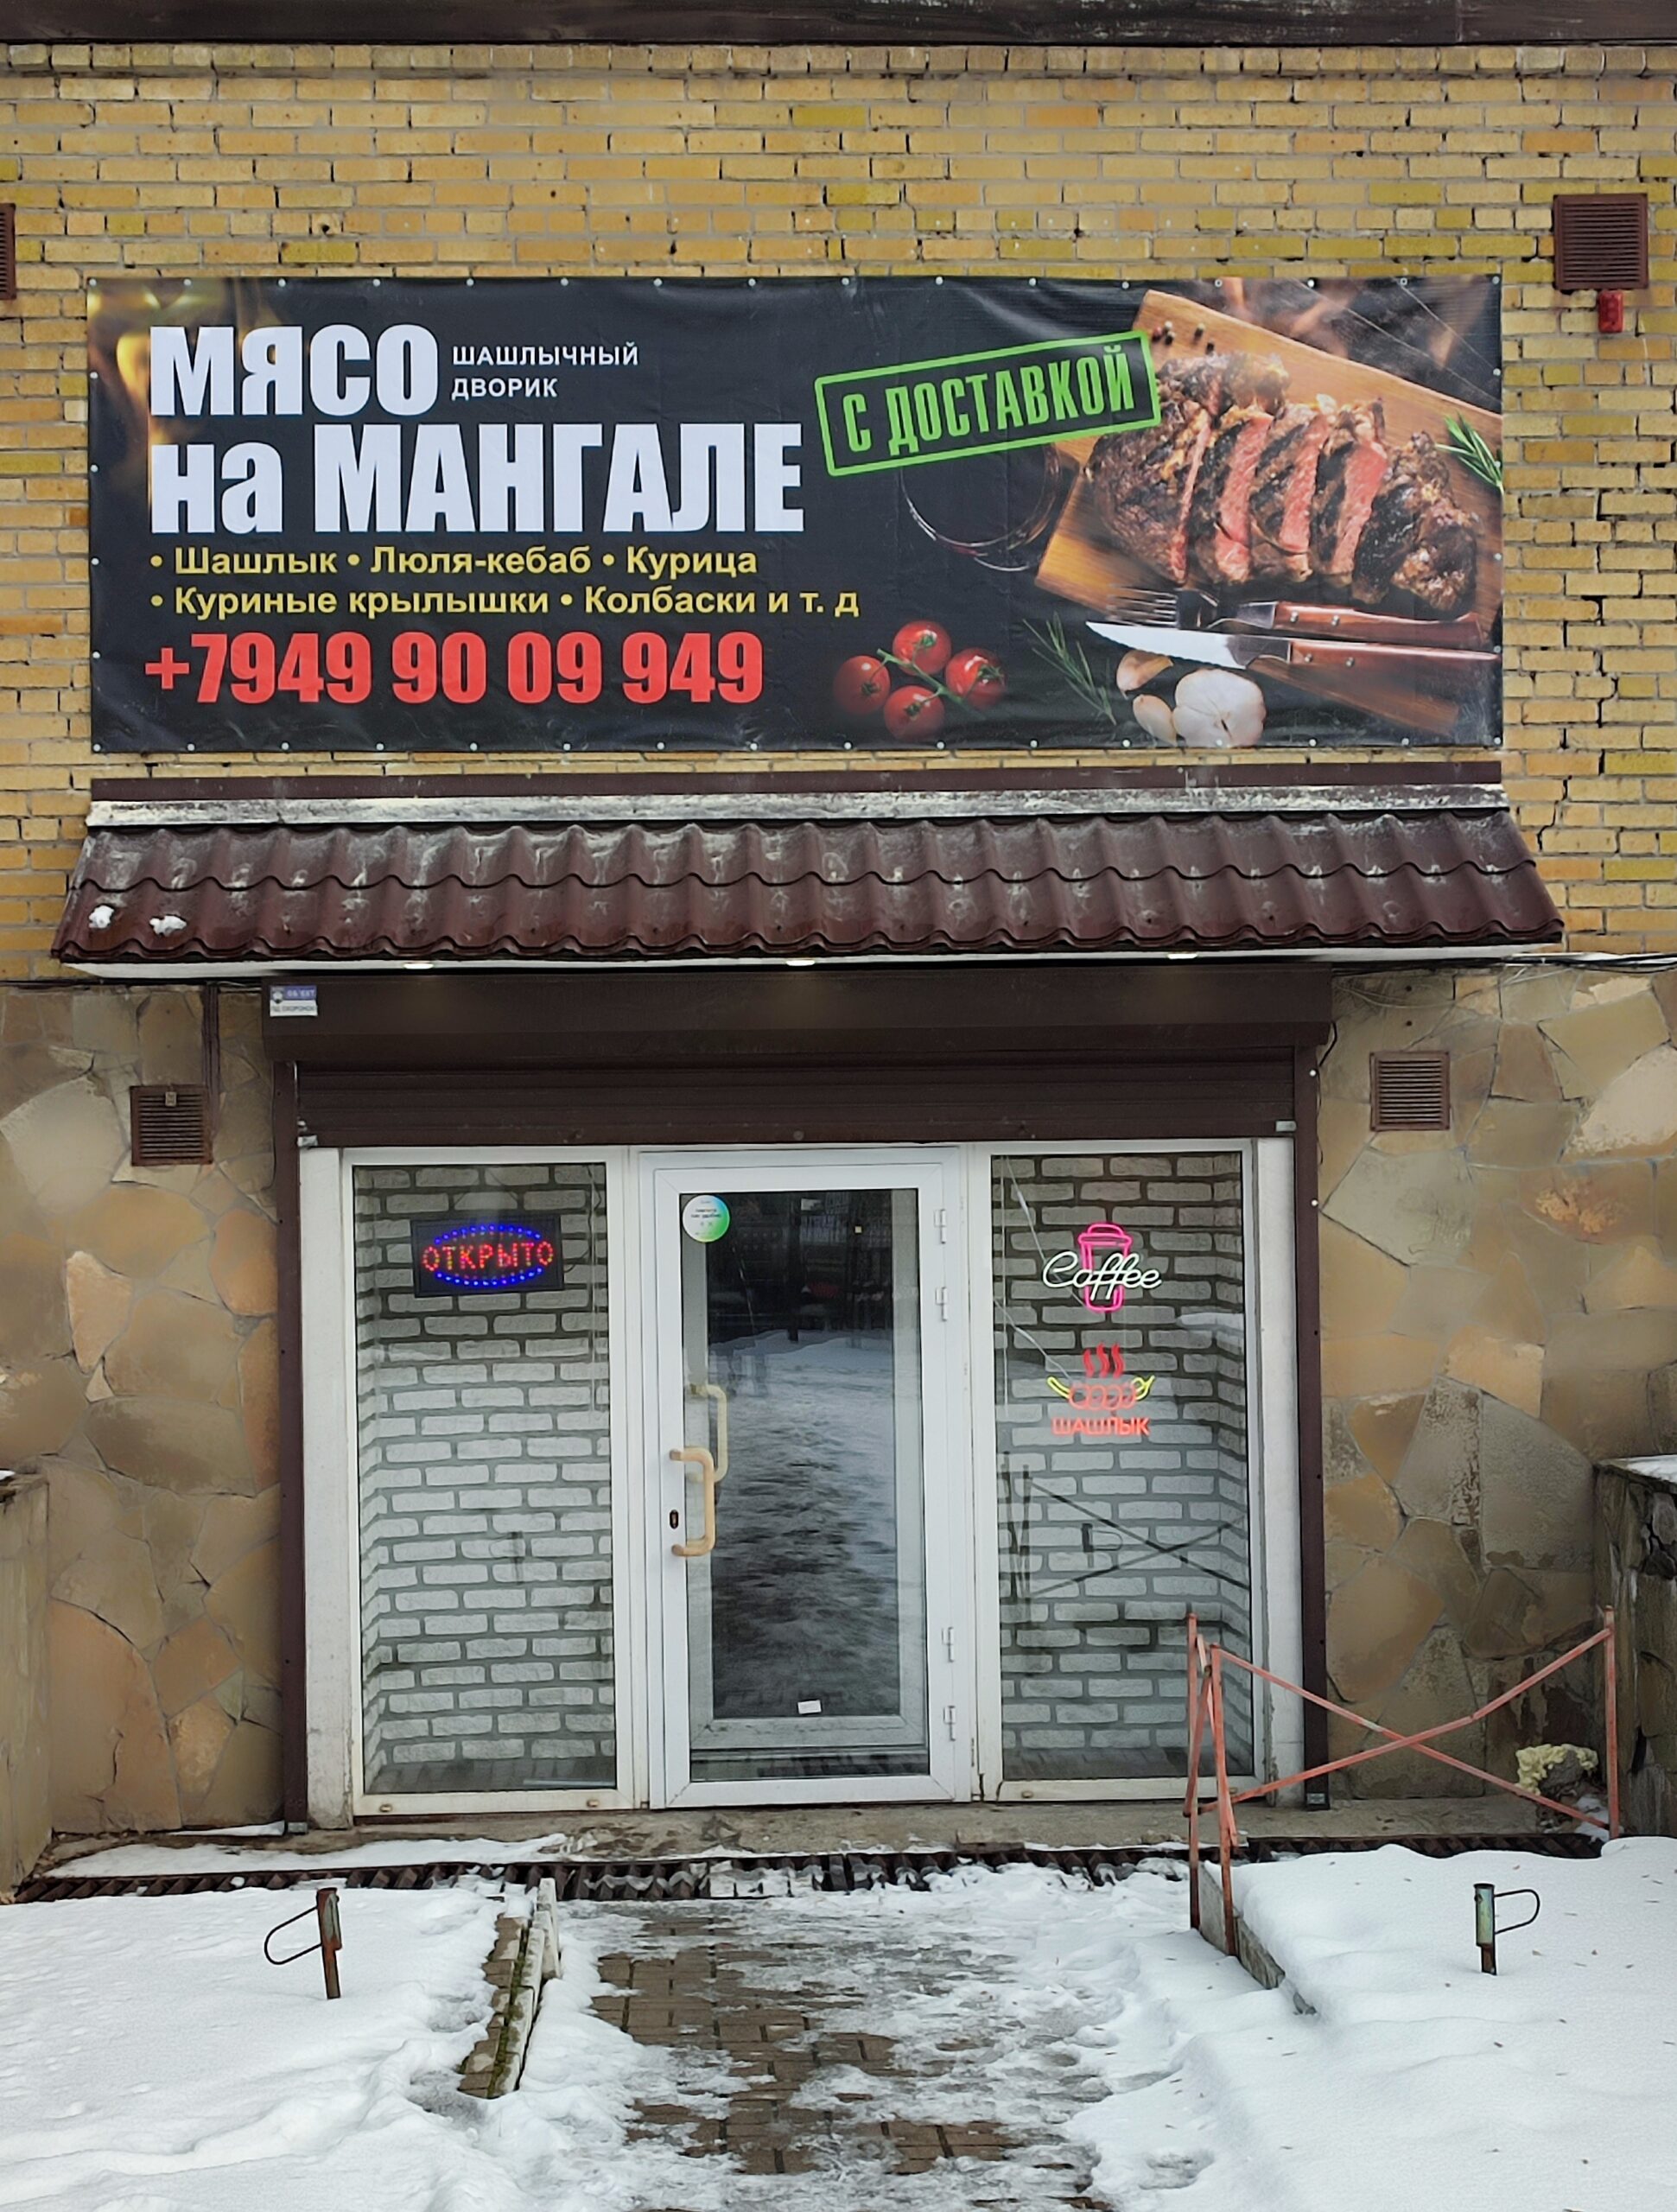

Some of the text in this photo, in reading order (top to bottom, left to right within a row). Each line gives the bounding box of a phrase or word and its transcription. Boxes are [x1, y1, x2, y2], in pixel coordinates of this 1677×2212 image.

[452, 341, 638, 365] ШАШЛЫЧНЫЙ
[451, 378, 558, 401] ДВОРИК
[842, 343, 1135, 456] С ДОСТАВКОЙ
[149, 423, 804, 534] на МАНГАЛЕ
[175, 545, 757, 580] Шашлык Люля-кебаб Курица
[175, 587, 337, 620] Куриные
[349, 592, 549, 620] крылышки
[585, 585, 755, 613] Колбаски
[768, 593, 789, 613] и
[835, 592, 860, 618] д
[145, 631, 763, 704] +7949 90 09 949
[422, 1240, 554, 1272] ОТКРЫТО
[1042, 1250, 1162, 1301] Coffee
[1051, 1416, 1151, 1436] ШАШЛЫК
